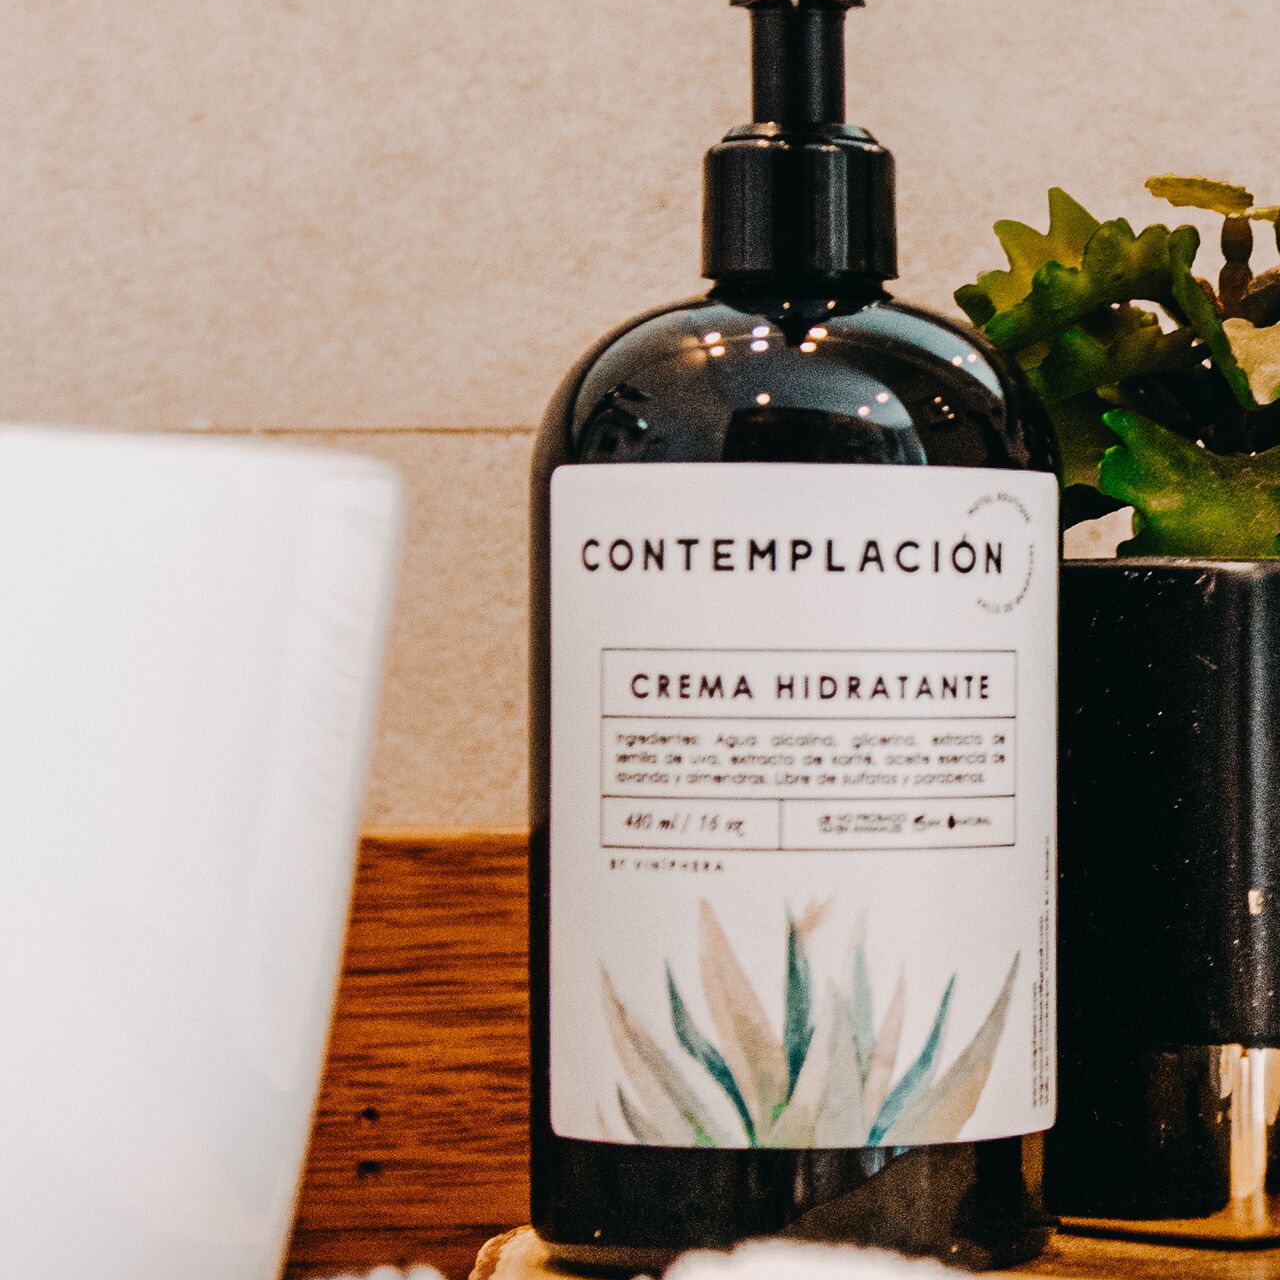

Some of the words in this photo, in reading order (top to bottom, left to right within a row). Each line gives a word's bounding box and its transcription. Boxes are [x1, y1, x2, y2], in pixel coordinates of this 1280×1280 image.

[581, 533, 1003, 574] CONTEMPLACIÓN
[630, 672, 755, 701] CREMA
[775, 673, 992, 701] HIDRATANTE
[715, 733, 757, 748] Agua
[665, 751, 683, 765] de
[730, 752, 794, 766] extracto
[802, 752, 822, 766] de
[884, 751, 930, 765] aceite
[817, 772, 837, 786] de
[842, 771, 898, 785] sulfatos
[657, 812, 680, 830] ml
[699, 814, 720, 831] 16
